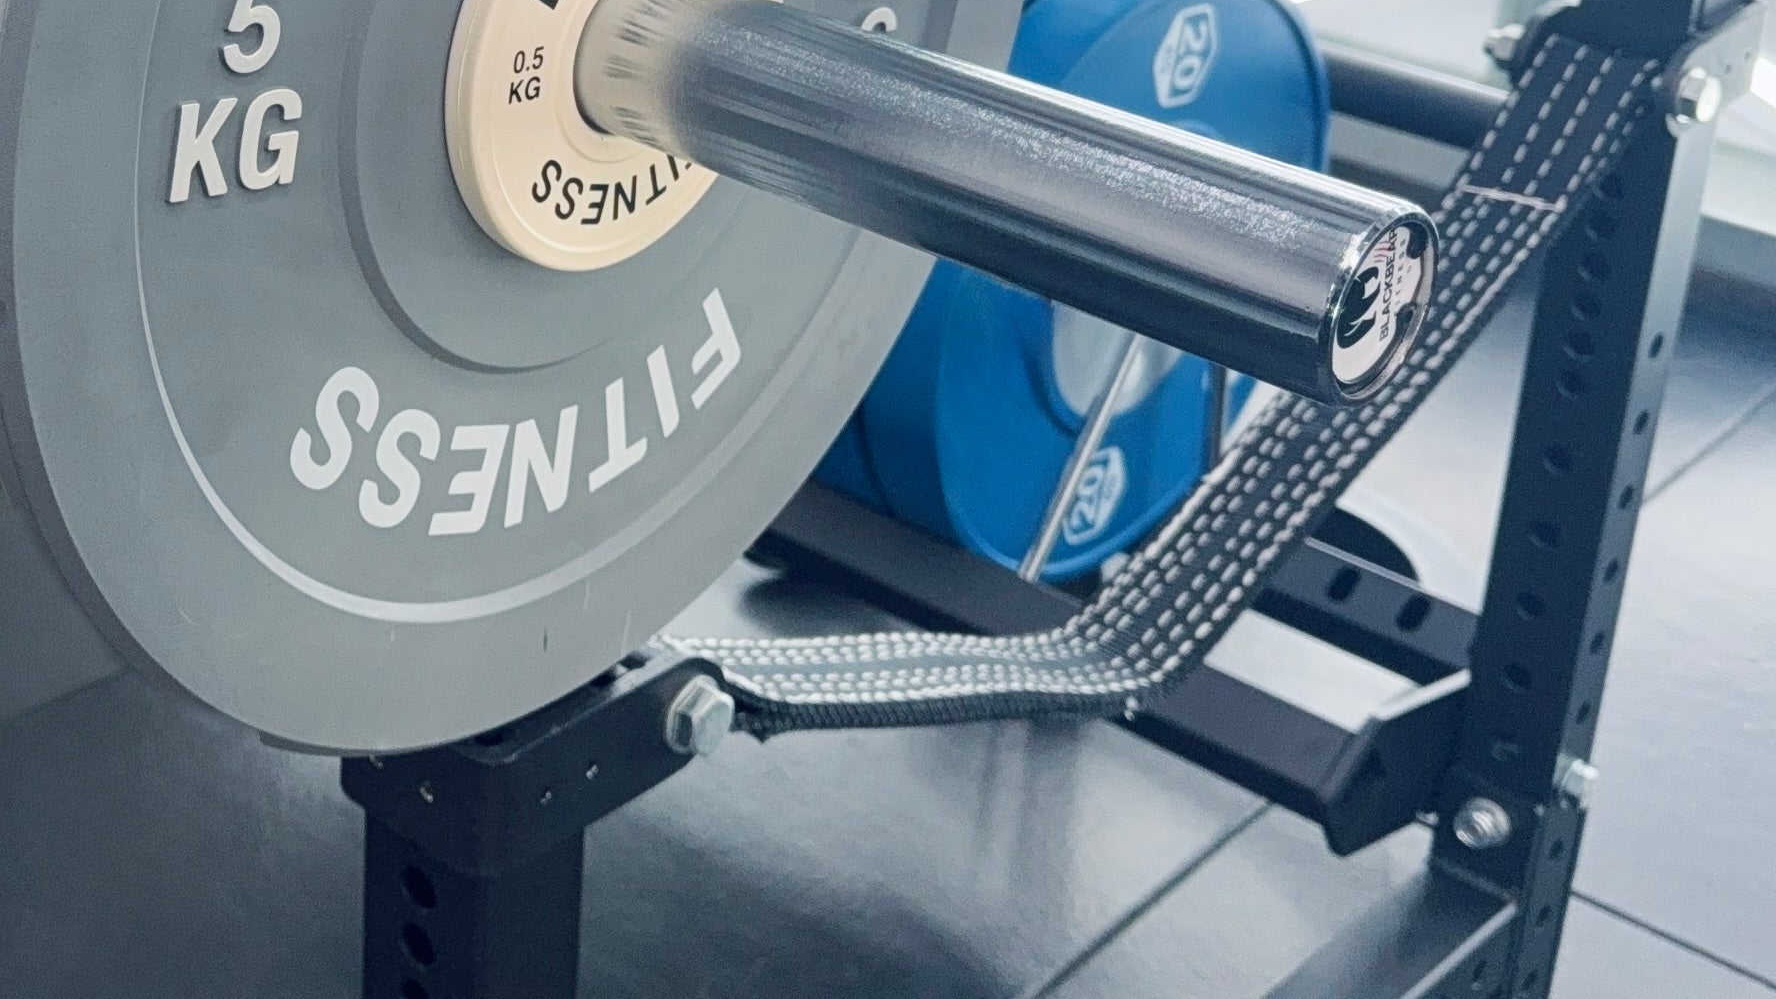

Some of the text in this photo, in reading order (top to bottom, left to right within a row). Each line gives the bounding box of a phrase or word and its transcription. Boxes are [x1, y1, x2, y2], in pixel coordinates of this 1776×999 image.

[508, 76, 541, 104] KG
[513, 46, 544, 75] 0.5
[1176, 19, 1208, 90] 20
[168, 88, 302, 204] KG
[531, 152, 691, 225] ITNESS
[289, 287, 742, 537] FITNESS
